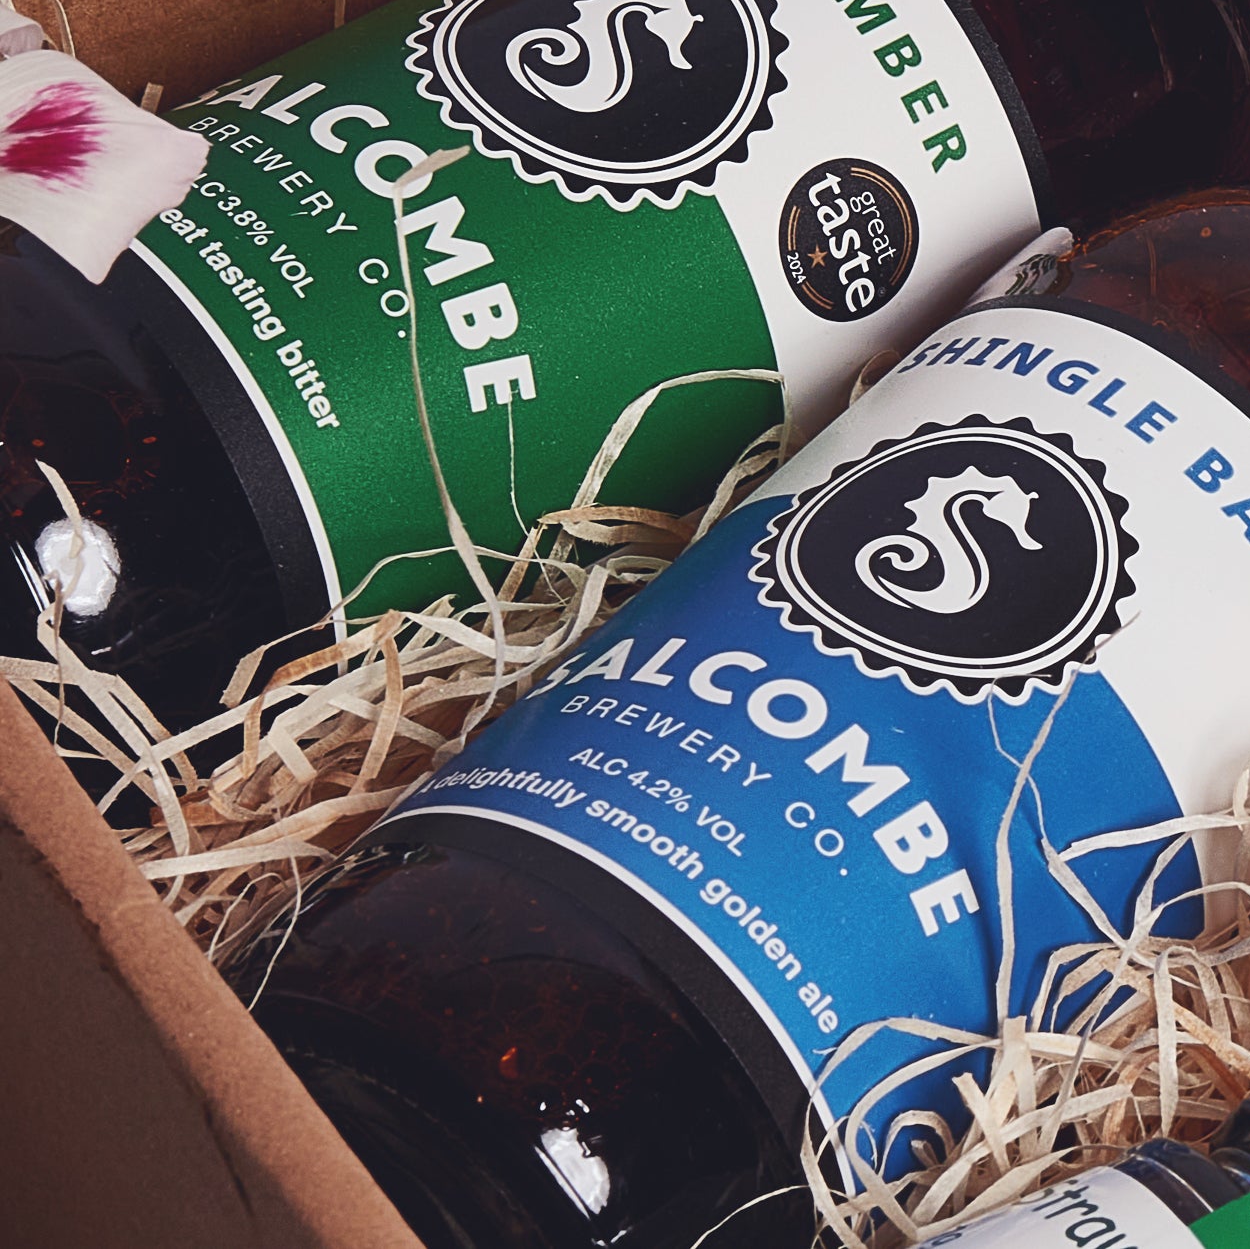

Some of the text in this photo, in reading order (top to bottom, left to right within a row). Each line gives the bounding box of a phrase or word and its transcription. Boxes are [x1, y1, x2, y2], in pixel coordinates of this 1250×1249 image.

[188, 116, 411, 339] BREWERY CO.
[190, 173, 315, 301] LC 3.8% VOL
[786, 252, 807, 284] 2024
[808, 172, 876, 313] taste
[850, 191, 897, 265] great
[159, 209, 341, 430] eat tasting bitter
[897, 336, 1177, 444] SHINGLE
[561, 695, 849, 877] BREWERY CO.
[568, 747, 747, 857] ALC 4.2% VOL
[434, 768, 587, 808] delightfully
[585, 795, 705, 881] smooth
[700, 876, 803, 981] golden
[798, 979, 840, 1035] ale
